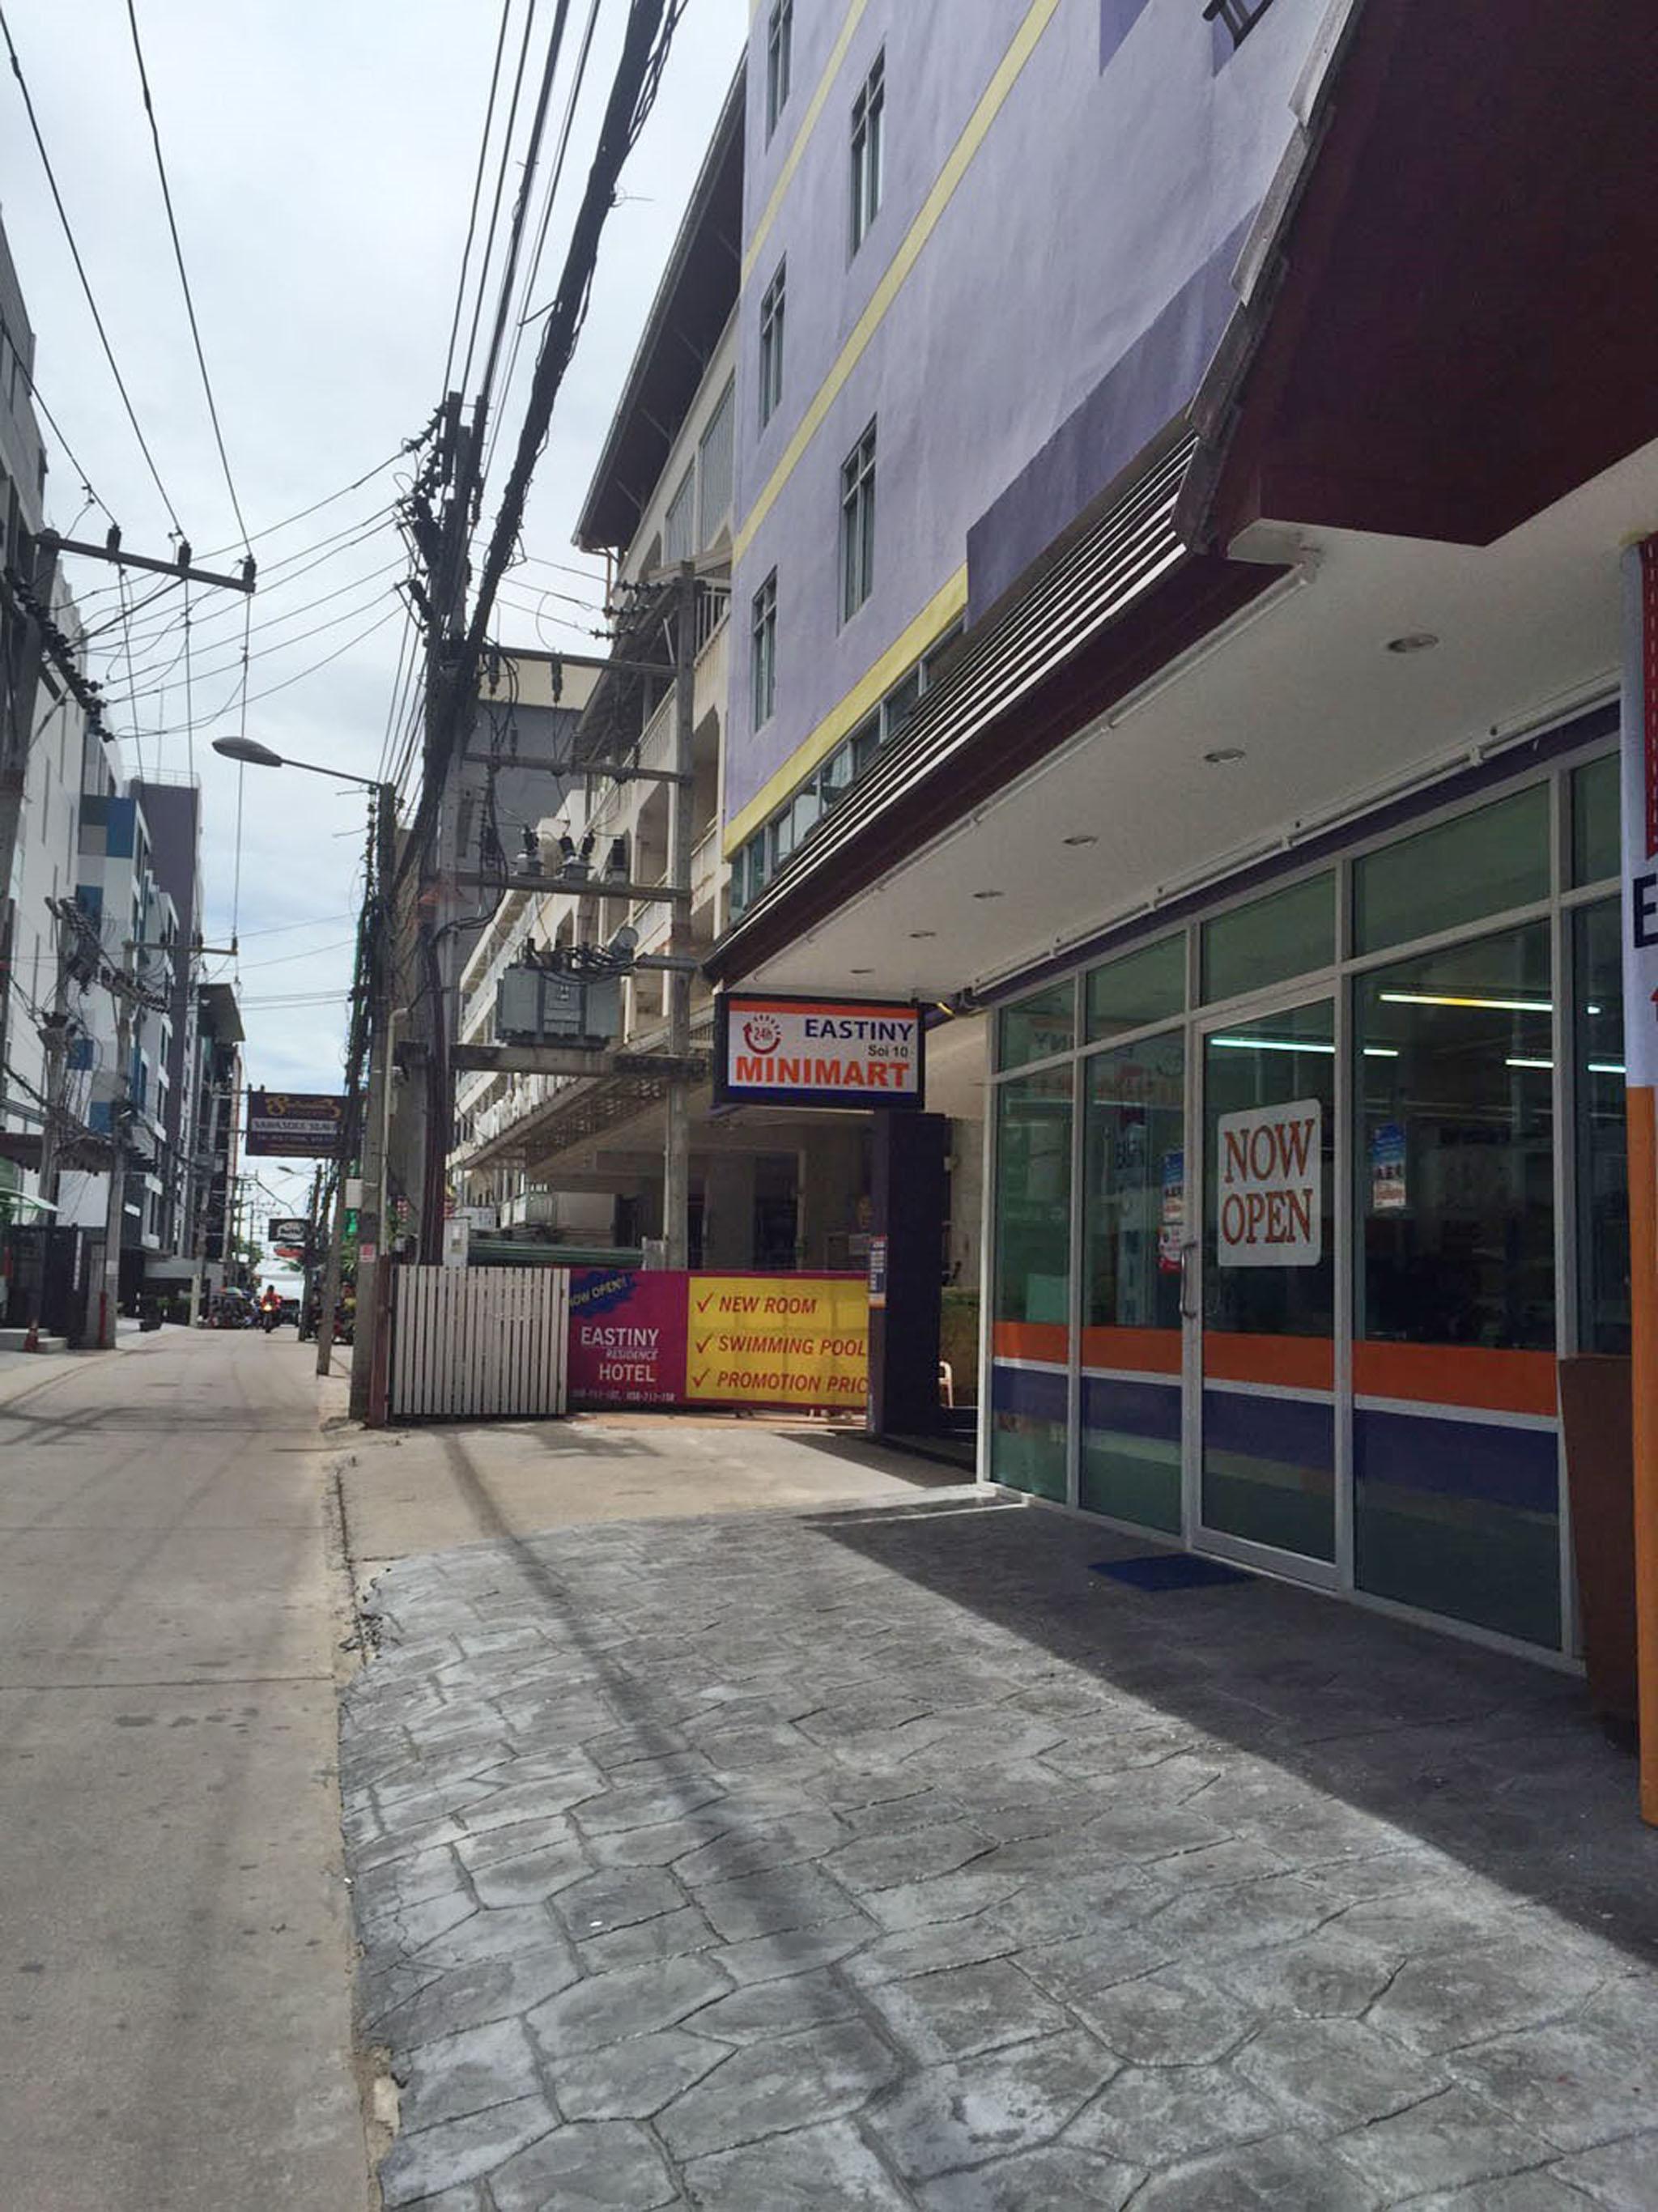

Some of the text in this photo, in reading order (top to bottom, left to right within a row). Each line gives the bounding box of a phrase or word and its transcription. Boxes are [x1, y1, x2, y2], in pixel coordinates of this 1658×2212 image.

[805, 1019, 913, 1041] EASTINY
[868, 1045, 908, 1057] Soi 10
[736, 1056, 910, 1087] MINIMART
[1224, 1119, 1314, 1182] NOW
[1222, 1189, 1313, 1245] OPEN
[719, 1297, 817, 1314] NEW ROOM
[580, 1326, 660, 1346] EASTINY
[719, 1335, 866, 1357] SWIMMING POOL
[606, 1349, 658, 1360] RESIDENCE
[599, 1363, 657, 1383] HOTEL
[716, 1372, 820, 1393] PROMOTION
